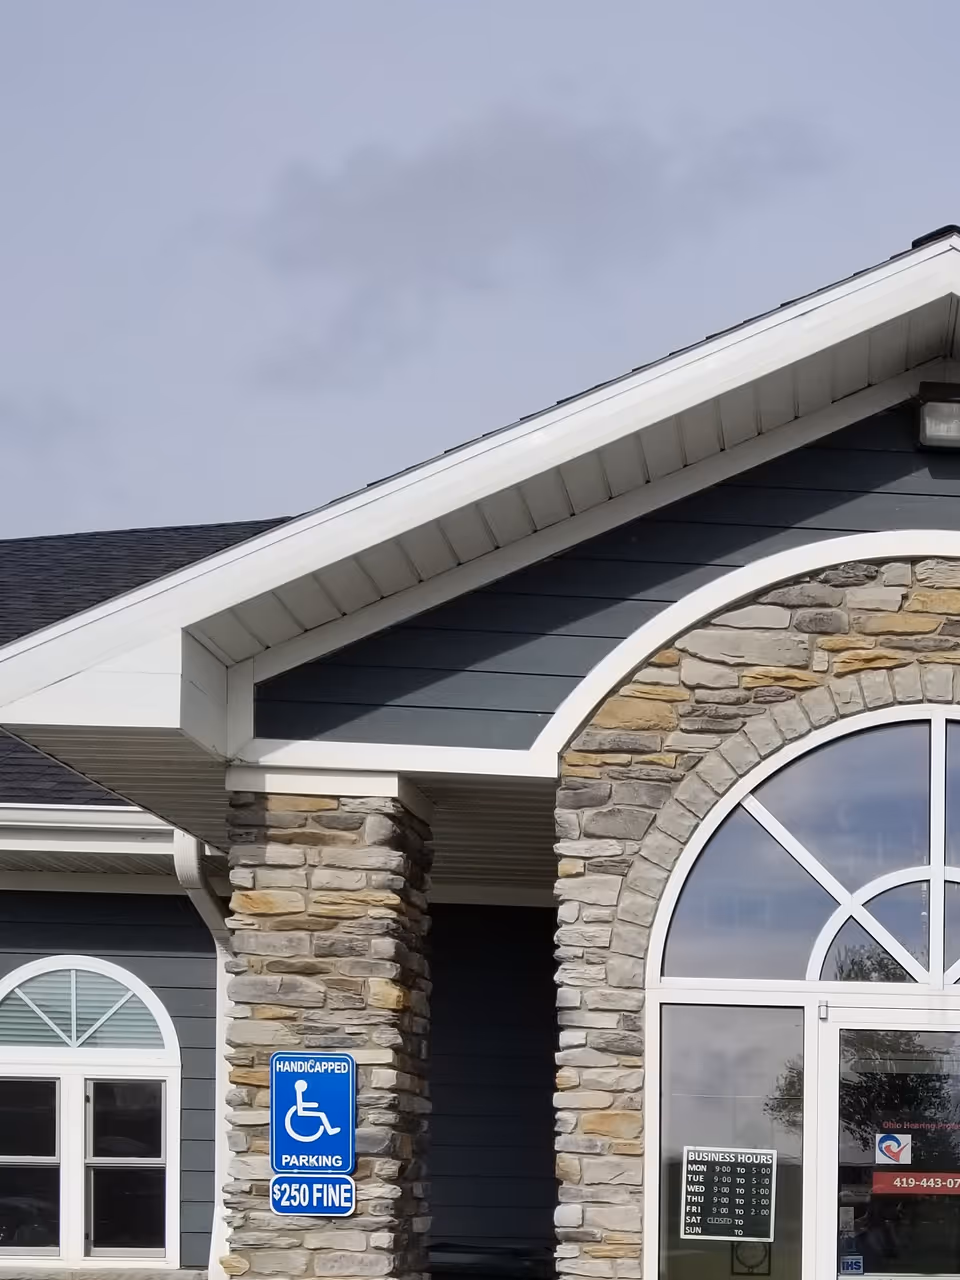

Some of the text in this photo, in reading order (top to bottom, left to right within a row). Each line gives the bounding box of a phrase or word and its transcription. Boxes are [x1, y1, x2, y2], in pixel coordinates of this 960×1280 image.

[276, 1061, 348, 1073] HANDICAPPED
[883, 1121, 902, 1129] Ohio
[282, 1155, 343, 1167] PARKING
[688, 1151, 773, 1164] BUSINESS HOURS
[688, 1164, 707, 1172] MON
[688, 1174, 704, 1182] TUE
[687, 1185, 705, 1193] WED
[273, 1183, 352, 1207] $250 FINE
[687, 1195, 704, 1203] THU
[686, 1216, 702, 1224] SAT
[706, 1217, 733, 1225] CLOSED
[685, 1226, 702, 1234] SUN
